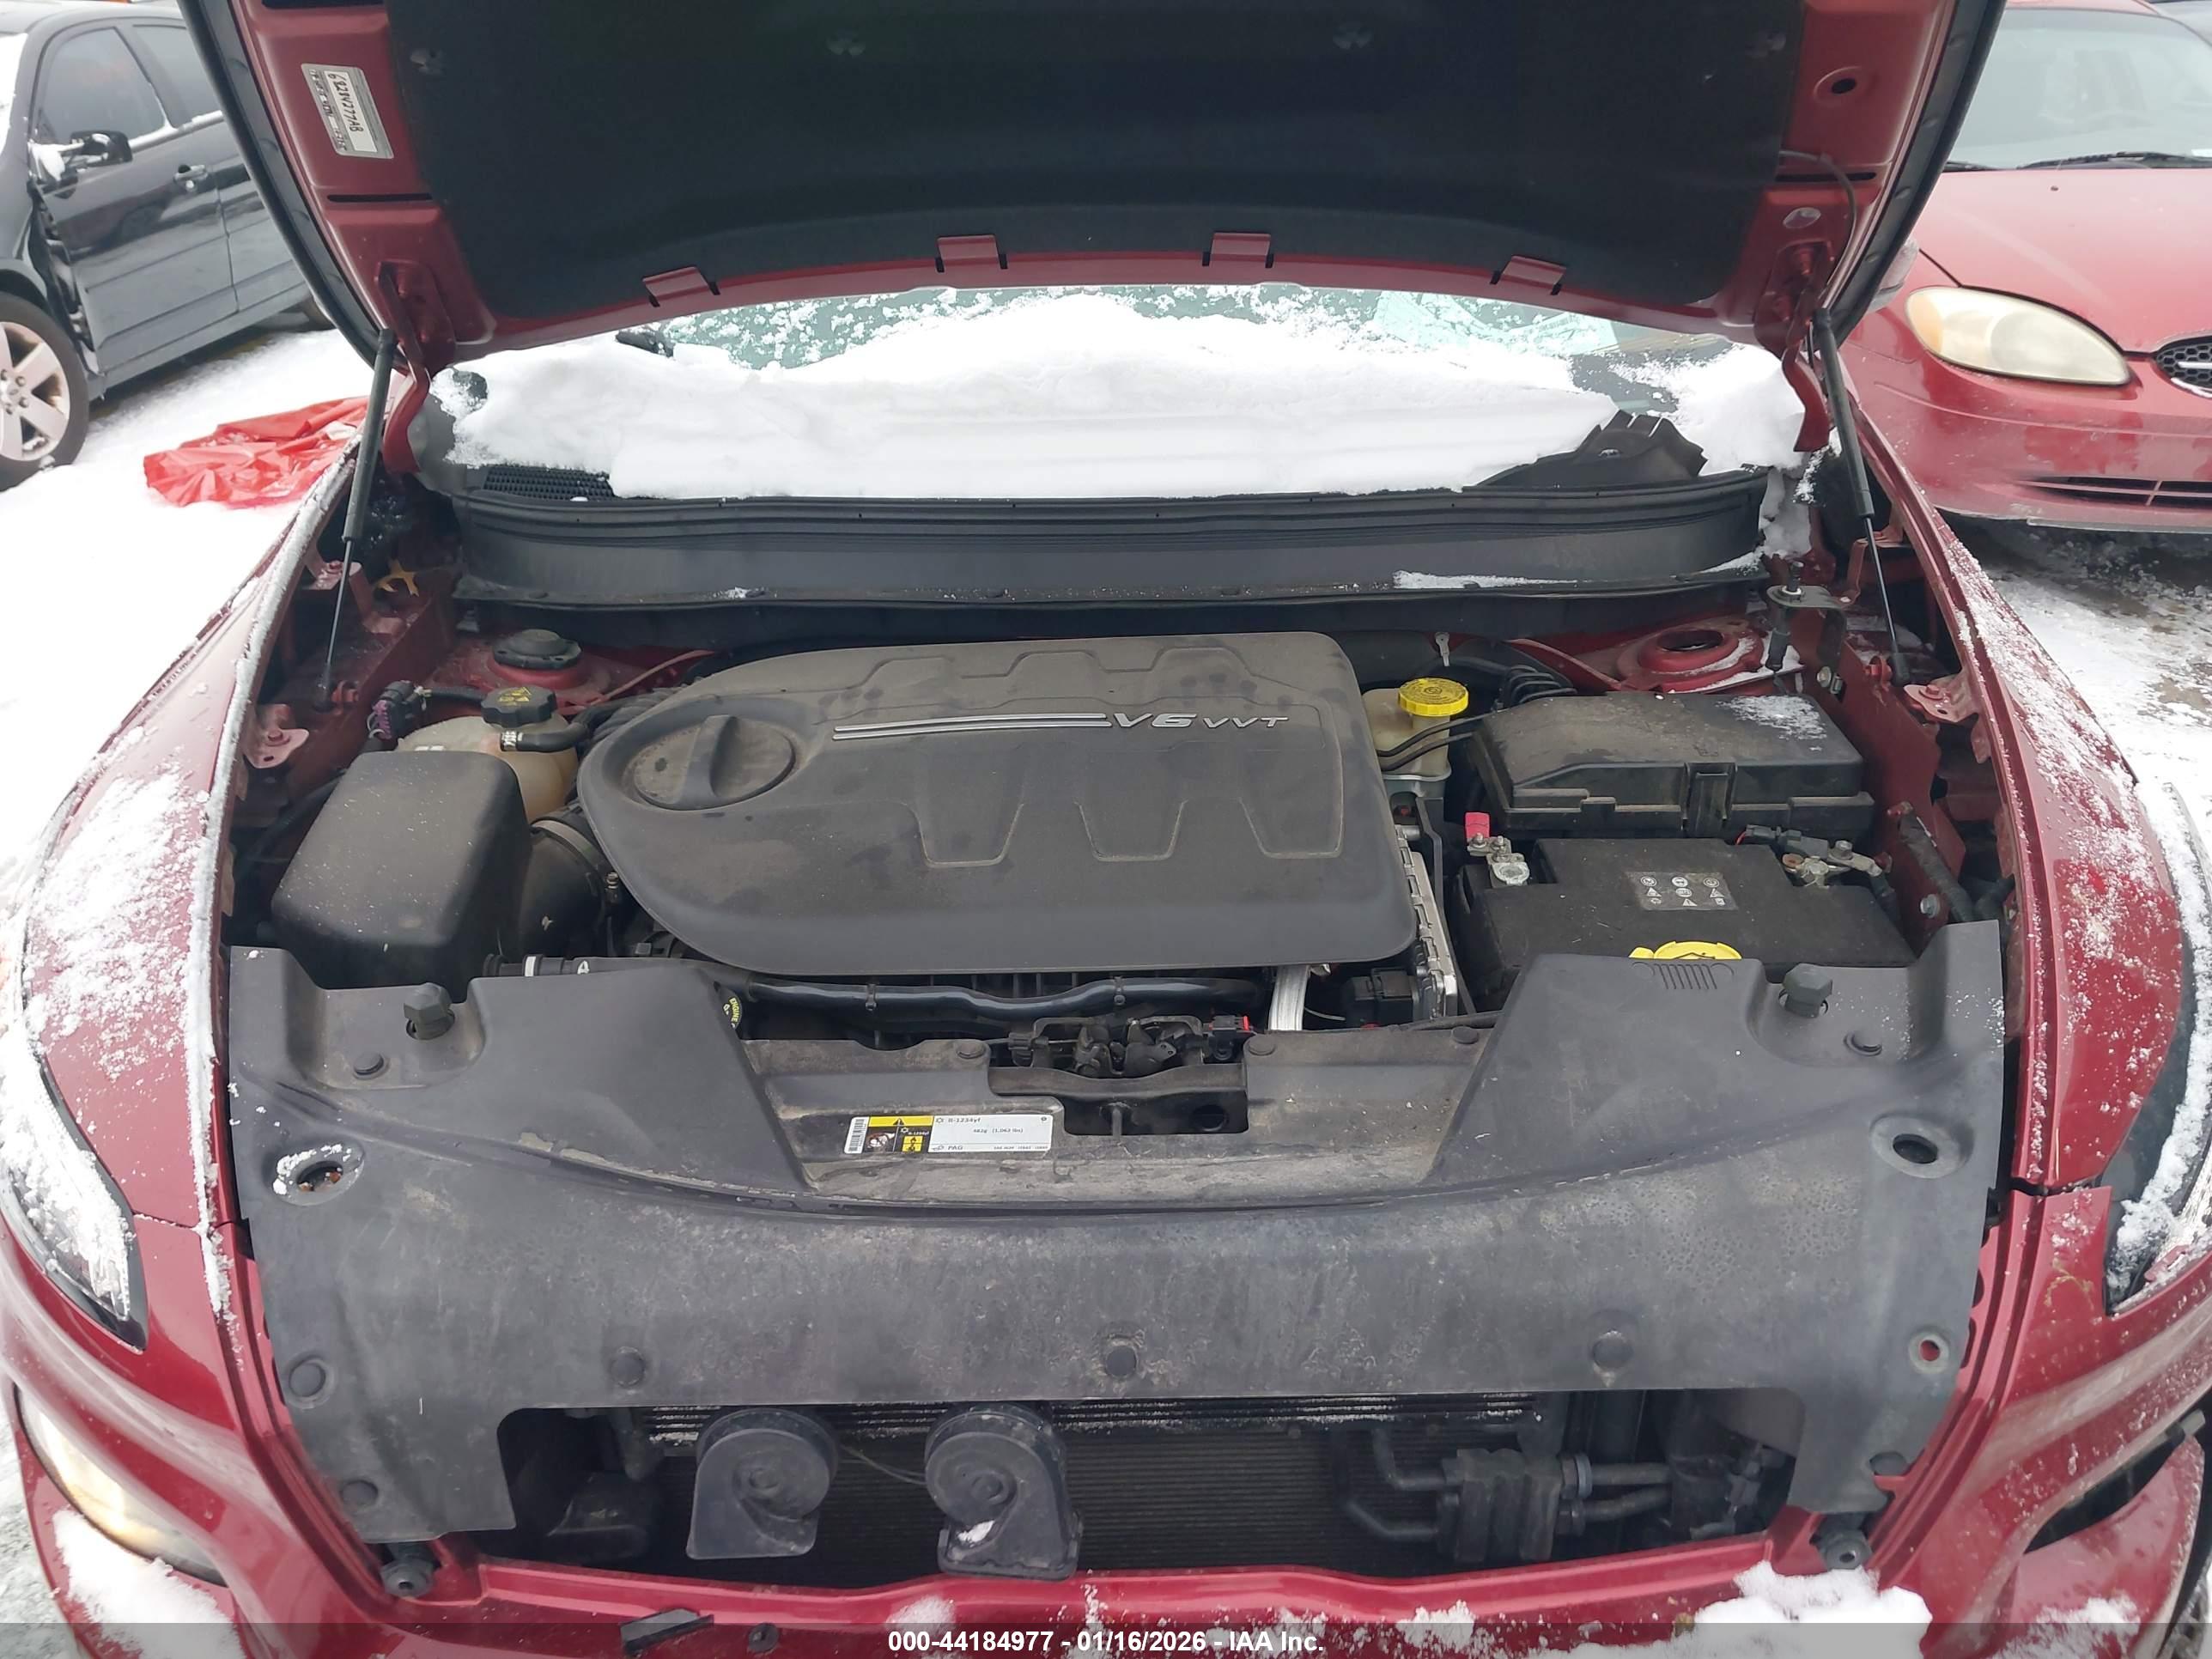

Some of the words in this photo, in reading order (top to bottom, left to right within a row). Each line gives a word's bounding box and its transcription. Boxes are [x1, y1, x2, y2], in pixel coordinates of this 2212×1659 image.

[1114, 713, 1197, 727] V6
[1203, 717, 1288, 728] VVT
[730, 997, 740, 1022] ENGINE
